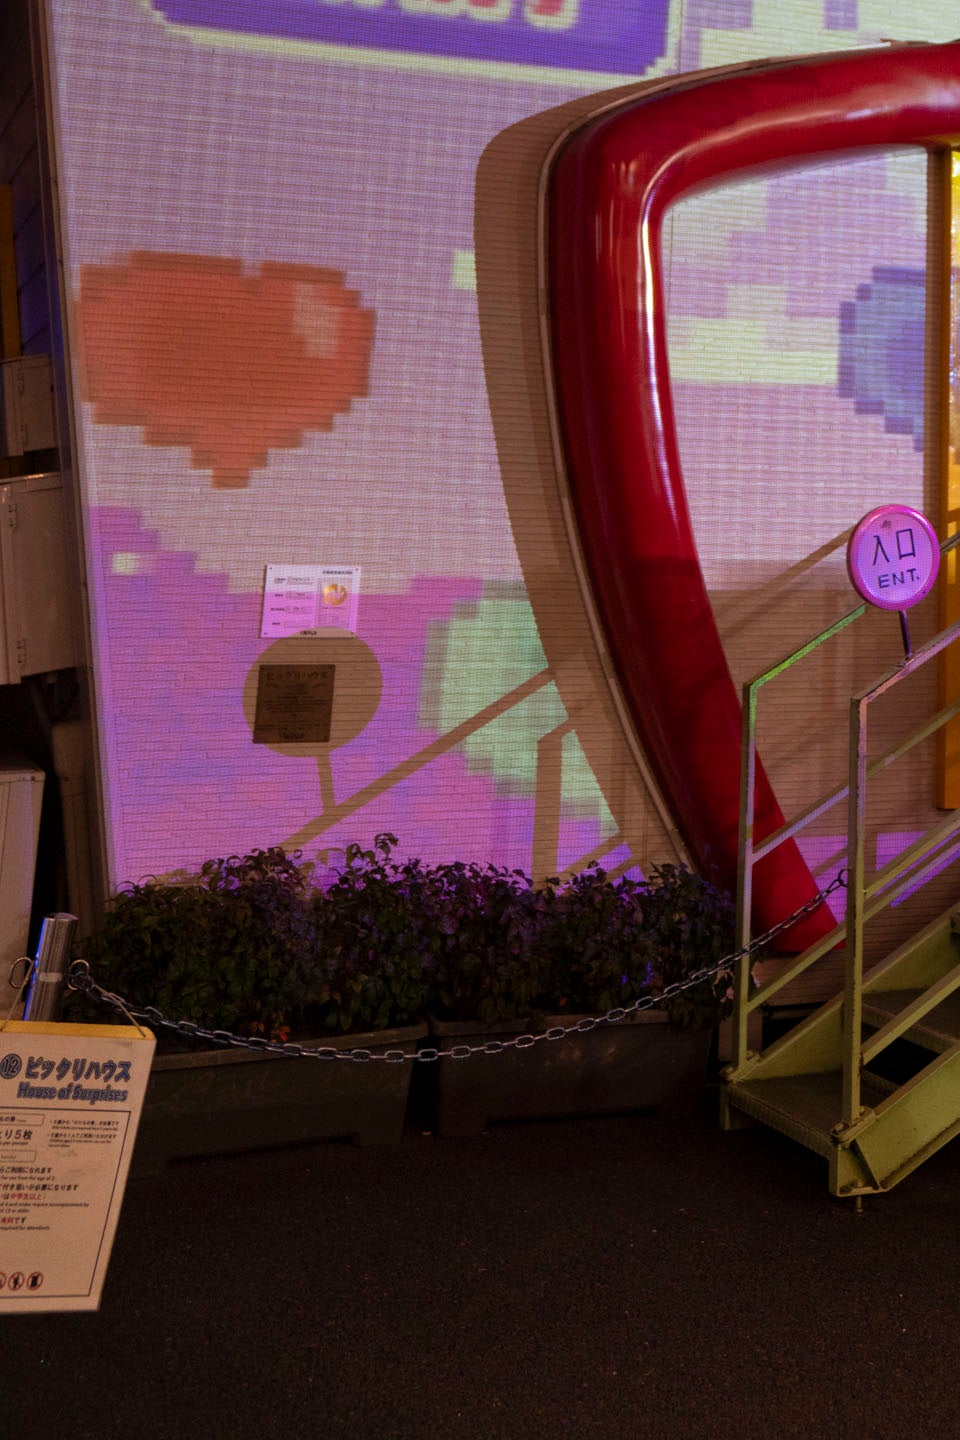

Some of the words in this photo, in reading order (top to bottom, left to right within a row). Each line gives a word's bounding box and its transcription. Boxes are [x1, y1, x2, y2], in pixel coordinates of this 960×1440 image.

[872, 528, 916, 566] 入口
[877, 568, 920, 588] ENT.
[17, 1081, 57, 1099] House
[57, 1082, 73, 1100] of
[72, 1084, 129, 1105] Surprises
